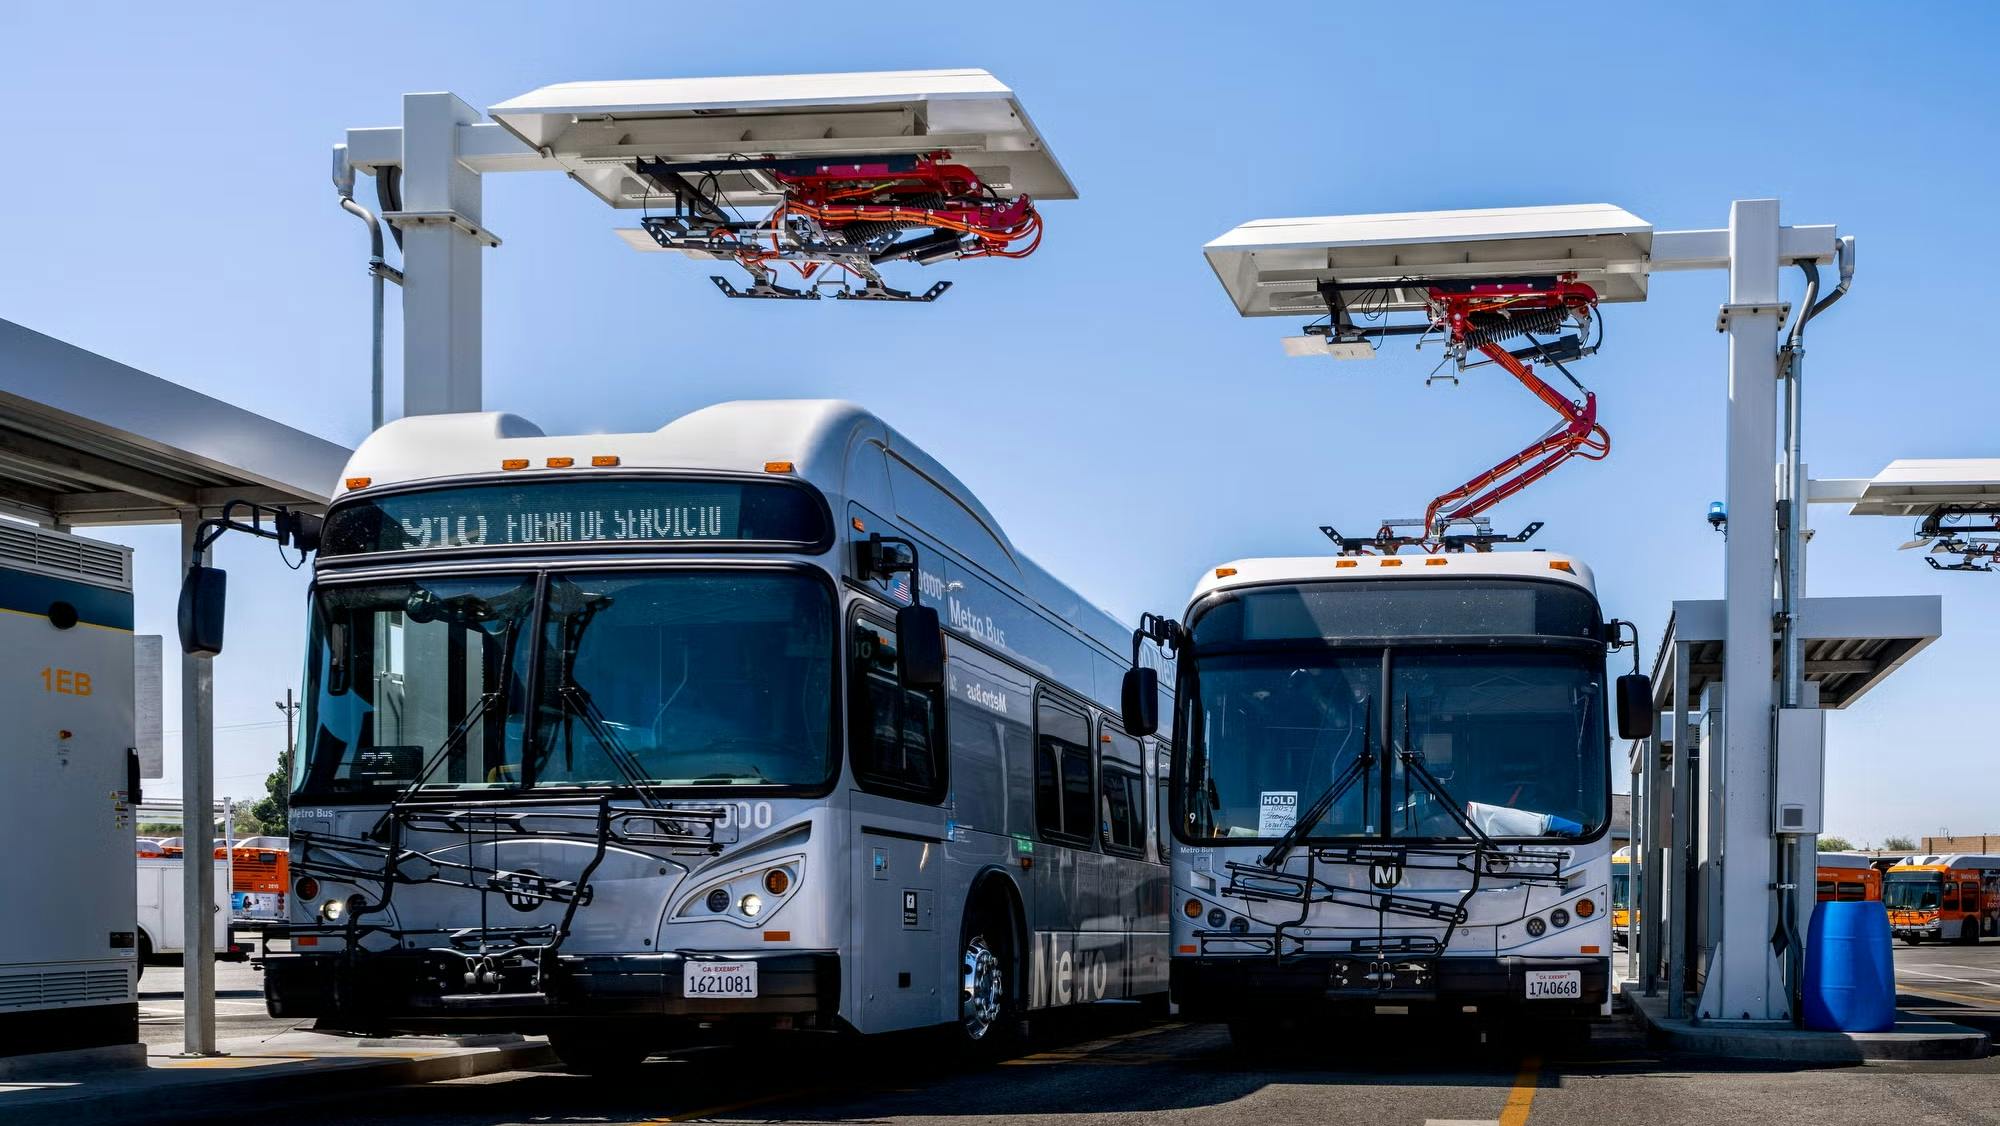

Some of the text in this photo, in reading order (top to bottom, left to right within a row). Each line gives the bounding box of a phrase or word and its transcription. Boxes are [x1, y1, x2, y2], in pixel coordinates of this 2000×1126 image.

[508, 506, 721, 543] FUERA DE SERVICIO
[950, 597, 1005, 647] Metro Bus
[41, 667, 92, 697] 1EB
[1263, 796, 1295, 805] HOLD
[289, 808, 333, 818] Metro Bus
[1374, 863, 1397, 884] M
[689, 976, 753, 993] 1621081
[1529, 981, 1578, 995] 1740668
